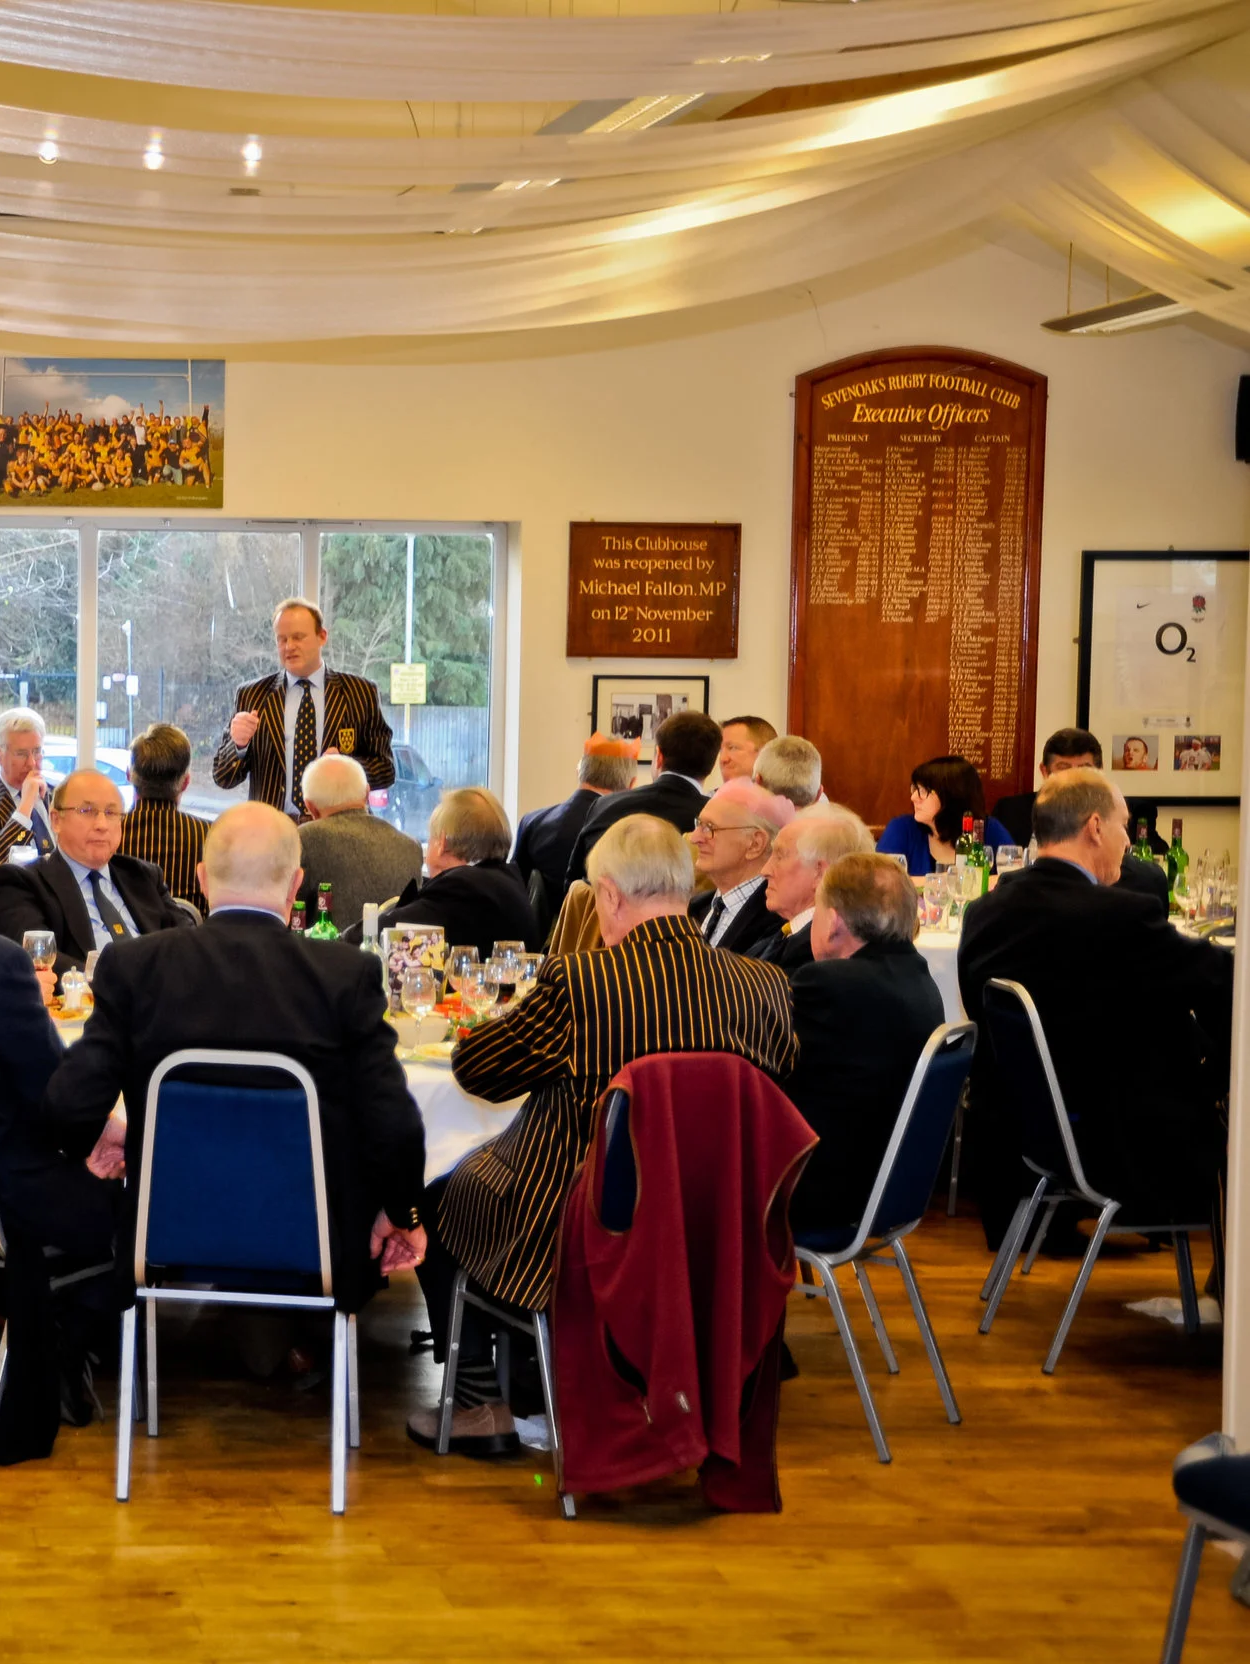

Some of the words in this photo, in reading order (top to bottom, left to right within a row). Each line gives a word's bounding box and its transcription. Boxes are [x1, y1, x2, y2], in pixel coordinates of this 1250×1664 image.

[821, 377, 887, 411] SEVENOAKS
[888, 374, 927, 391] RUGBY
[929, 374, 988, 398] FOOTBALL
[990, 386, 1021, 410] CLUB
[852, 403, 926, 423] Executive
[928, 403, 991, 431] Officers
[827, 434, 870, 442] PRESIDENT
[900, 434, 942, 443] SECRETARY
[974, 434, 1010, 443] CAPTAIN
[602, 536, 632, 550] This
[635, 536, 708, 551] Clubhouse
[593, 558, 620, 569] was
[624, 557, 693, 574] reopened
[696, 557, 715, 574] by
[579, 579, 640, 595] Michael
[700, 581, 726, 597] MP
[591, 609, 610, 620] on
[636, 606, 714, 621] November
[632, 628, 671, 643] 2011
